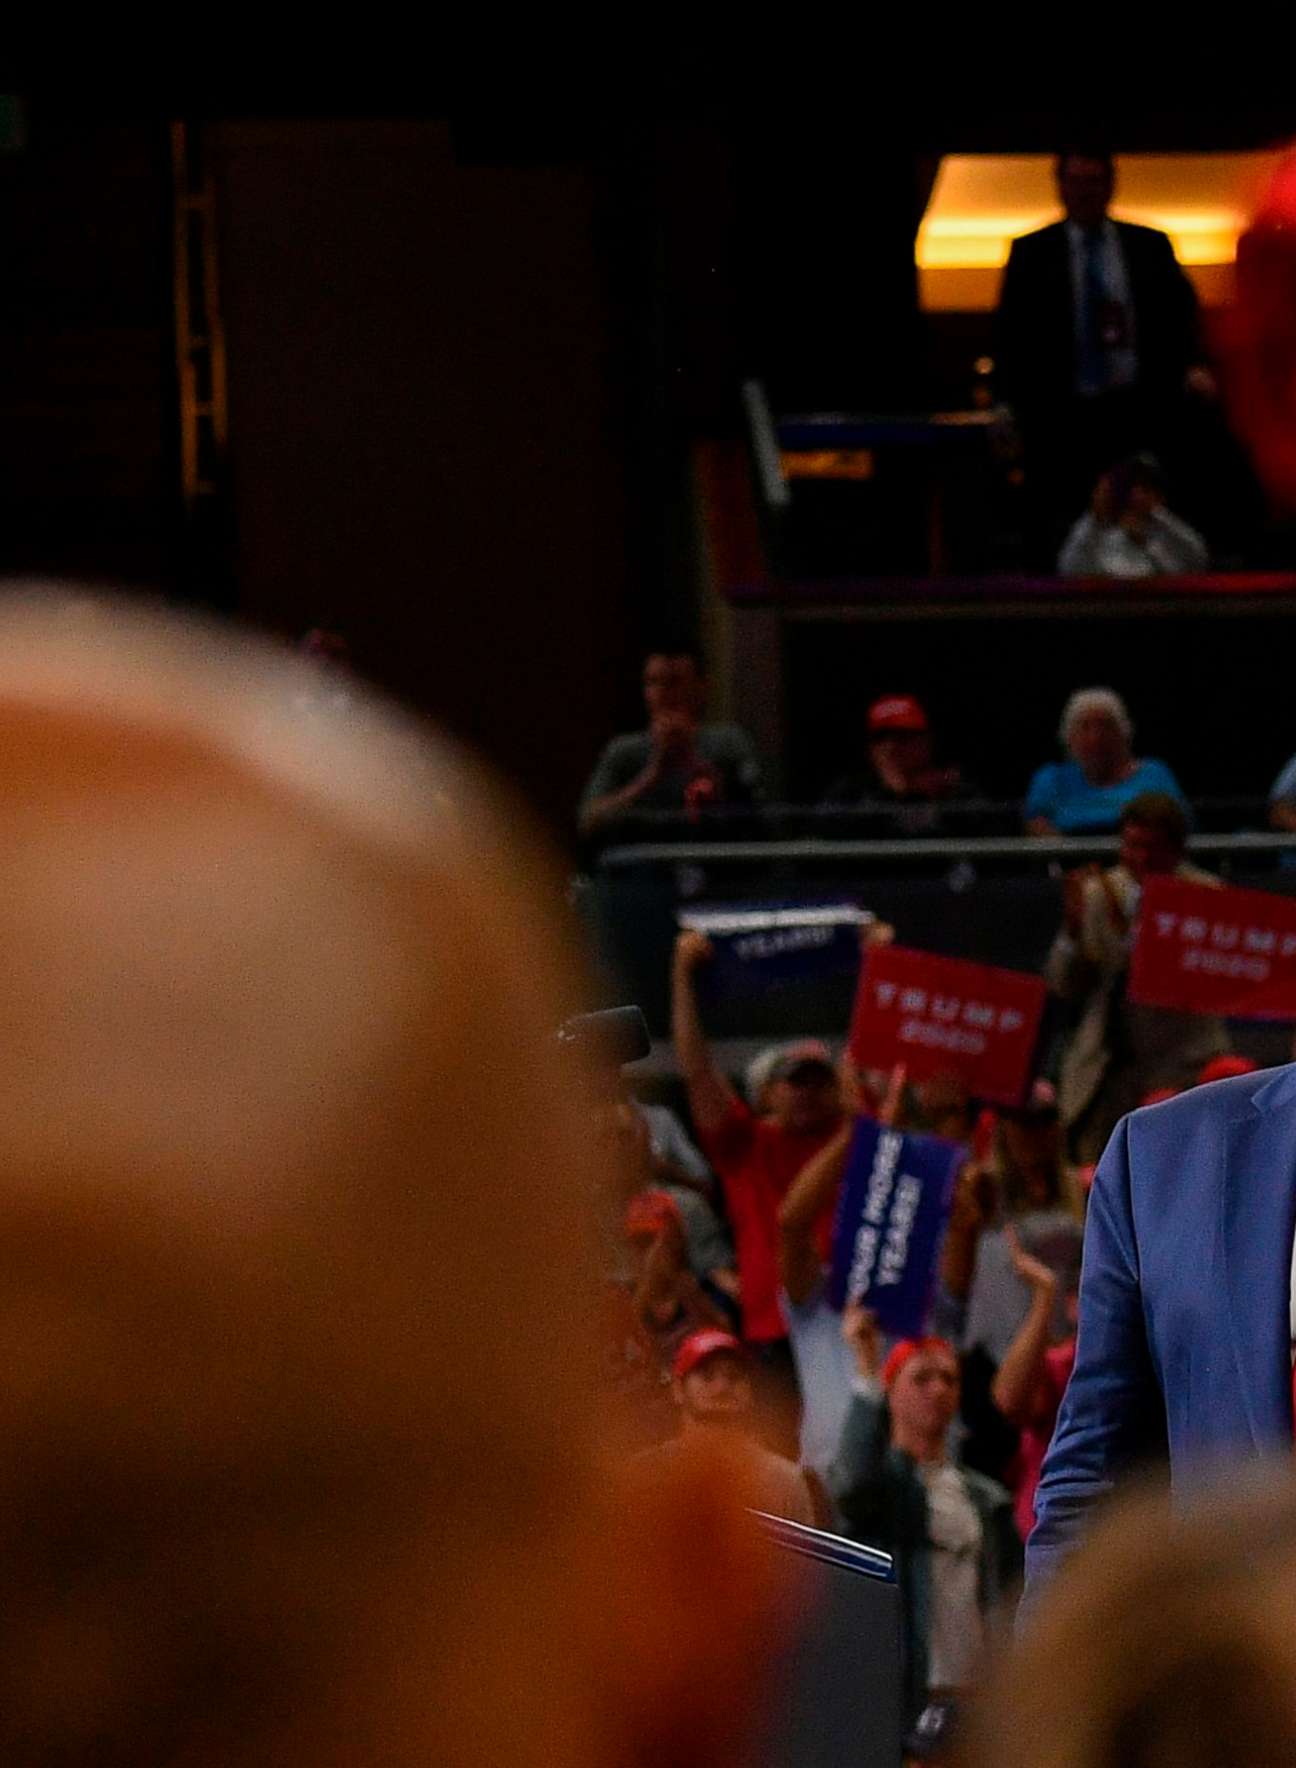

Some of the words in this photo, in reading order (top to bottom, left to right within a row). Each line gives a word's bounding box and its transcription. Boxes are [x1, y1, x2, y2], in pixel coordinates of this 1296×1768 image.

[1181, 948, 1271, 983] 2020
[876, 980, 1025, 1034] TRUMP
[900, 1017, 987, 1055] 2020
